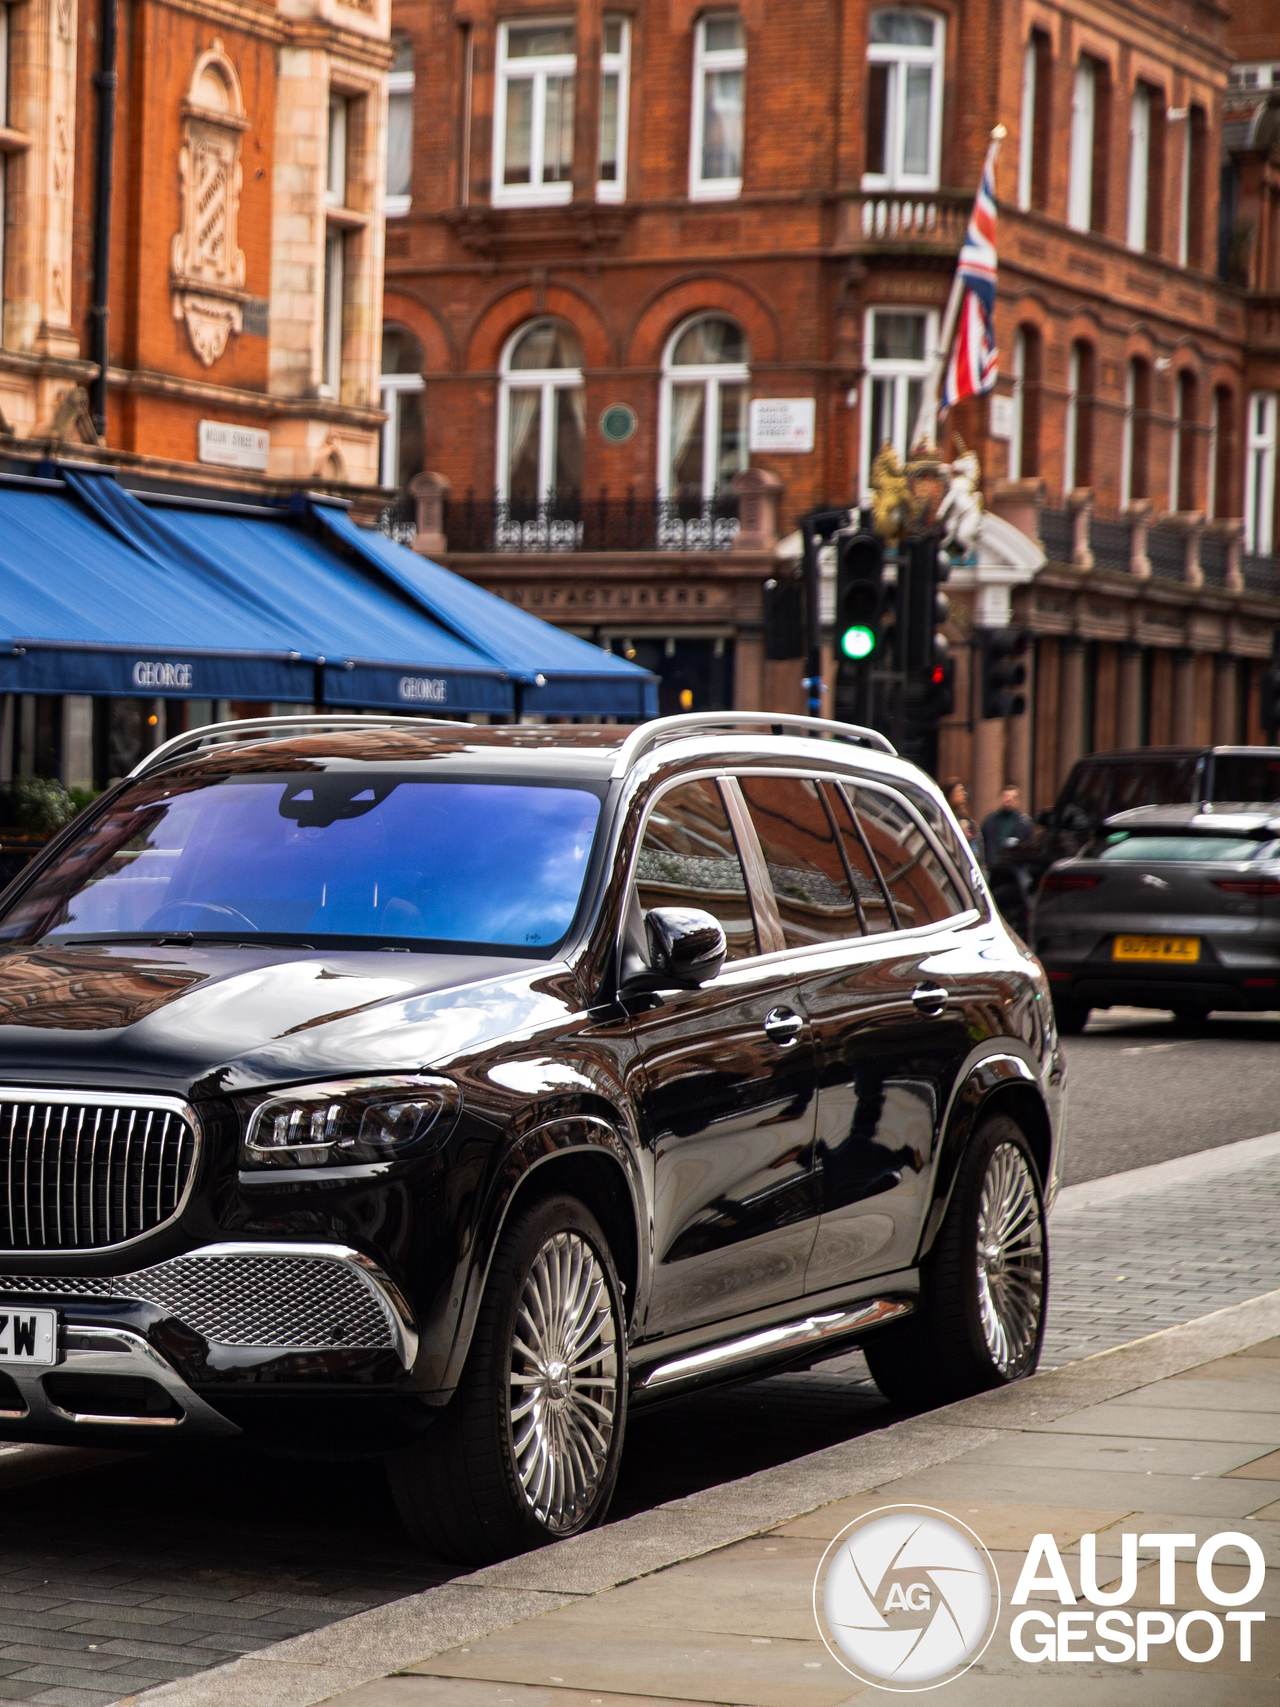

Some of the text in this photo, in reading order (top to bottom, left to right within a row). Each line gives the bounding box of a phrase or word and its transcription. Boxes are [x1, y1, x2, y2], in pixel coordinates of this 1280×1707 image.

[493, 586, 708, 606] ANUFACTURERS
[132, 661, 193, 690] GEORGE
[398, 676, 447, 704] GEORGE
[496, 1387, 520, 1498] MICHELIN
